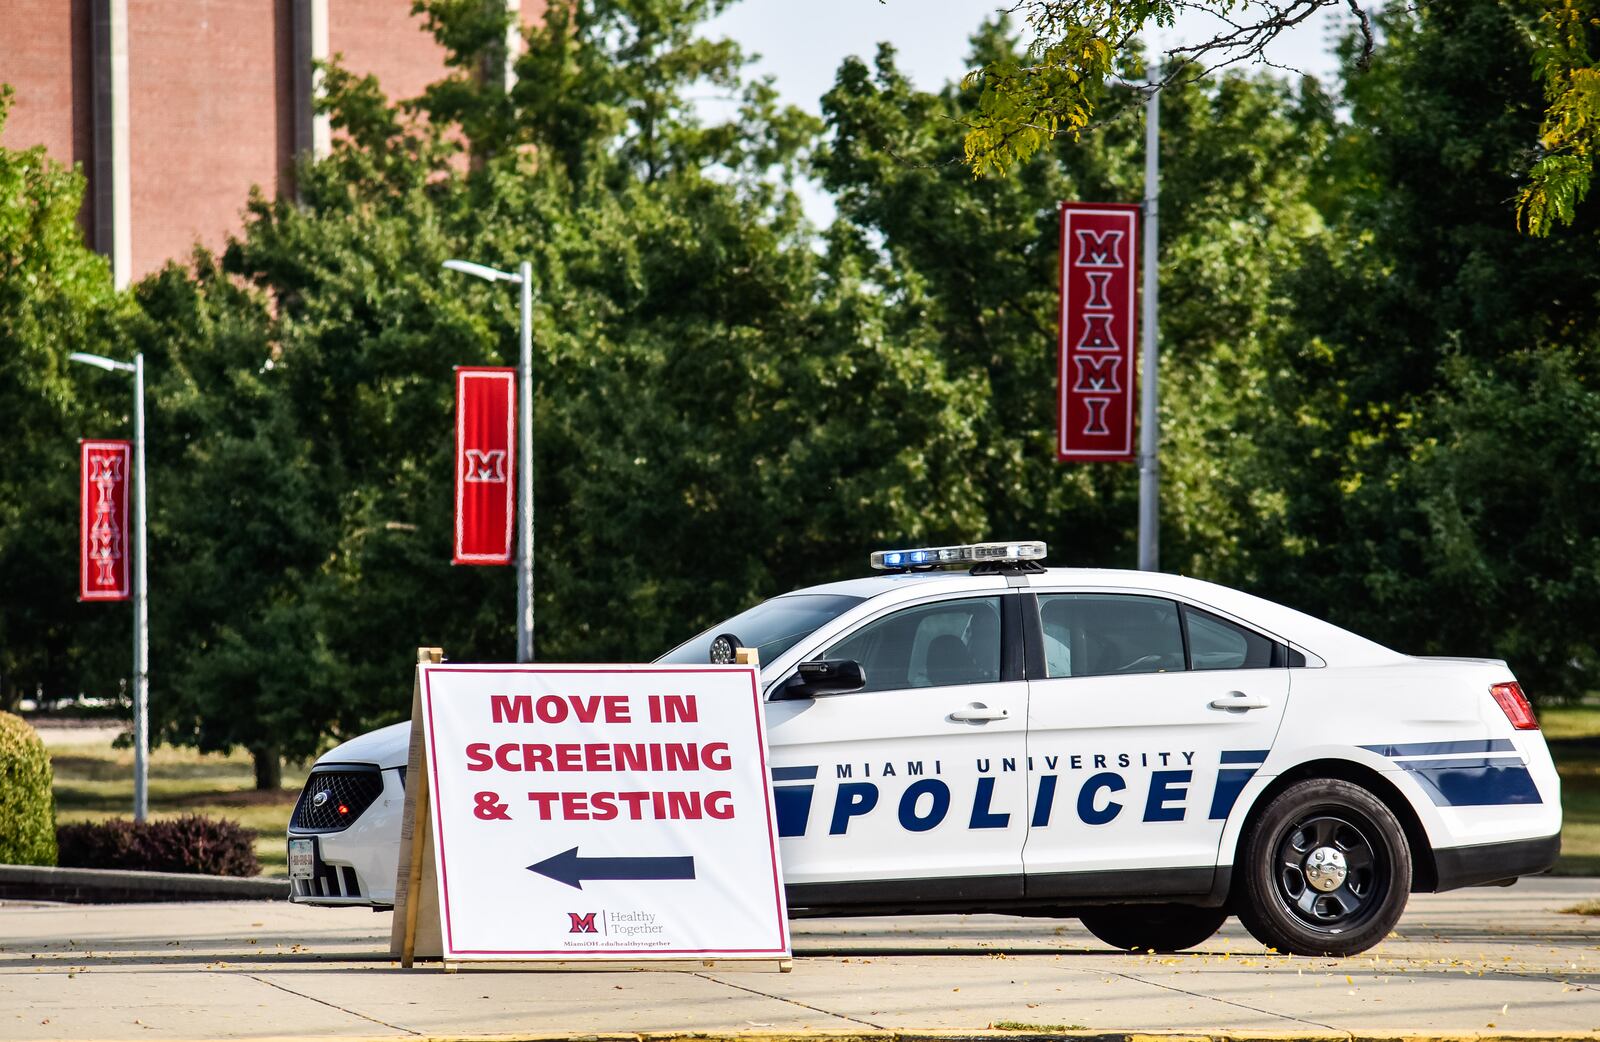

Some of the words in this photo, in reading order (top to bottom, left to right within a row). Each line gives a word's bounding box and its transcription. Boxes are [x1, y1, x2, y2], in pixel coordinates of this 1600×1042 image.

[1073, 229, 1125, 435] MIAMI
[464, 449, 506, 483] M
[89, 455, 122, 585] MIAMI
[490, 694, 632, 724] MOVE
[648, 694, 699, 724] IN
[465, 742, 733, 772] SCREENING
[836, 760, 942, 779] MIAMI
[976, 751, 1197, 773] UNIVERSITY
[473, 790, 513, 821] &
[528, 790, 735, 821] TESTING
[828, 769, 1195, 836] POLICE
[567, 912, 599, 934] M
[610, 911, 656, 924] Healthy
[611, 924, 664, 937] Together
[563, 940, 671, 948] MiamiOH.edu/healthytogether
